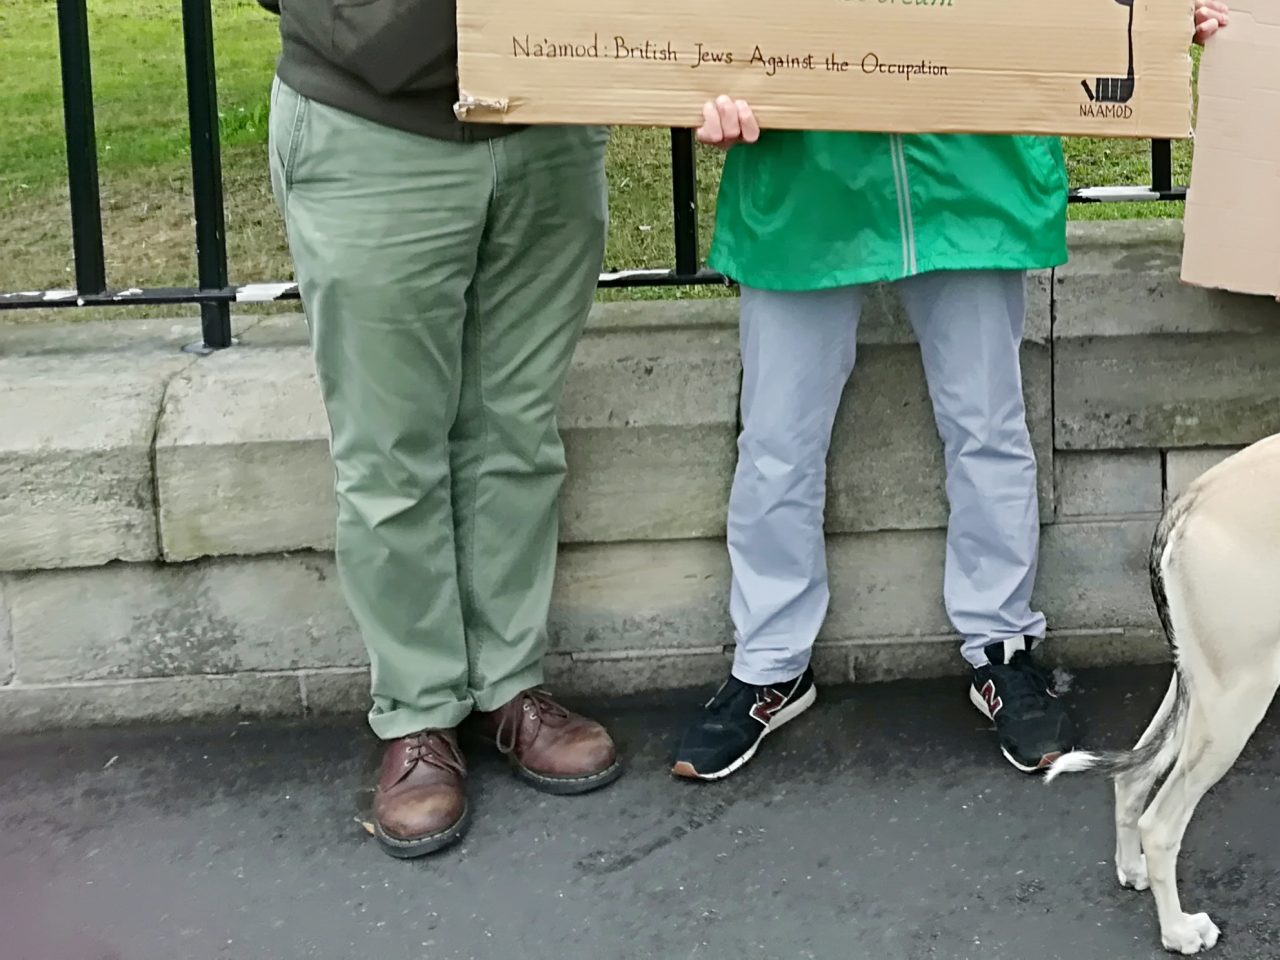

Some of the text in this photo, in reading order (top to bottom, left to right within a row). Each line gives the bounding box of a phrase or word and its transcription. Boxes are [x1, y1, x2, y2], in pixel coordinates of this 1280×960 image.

[613, 36, 678, 61] British
[691, 43, 733, 68] Jews
[750, 45, 816, 76] Against
[825, 52, 849, 72] the
[861, 52, 949, 80] Occupation
